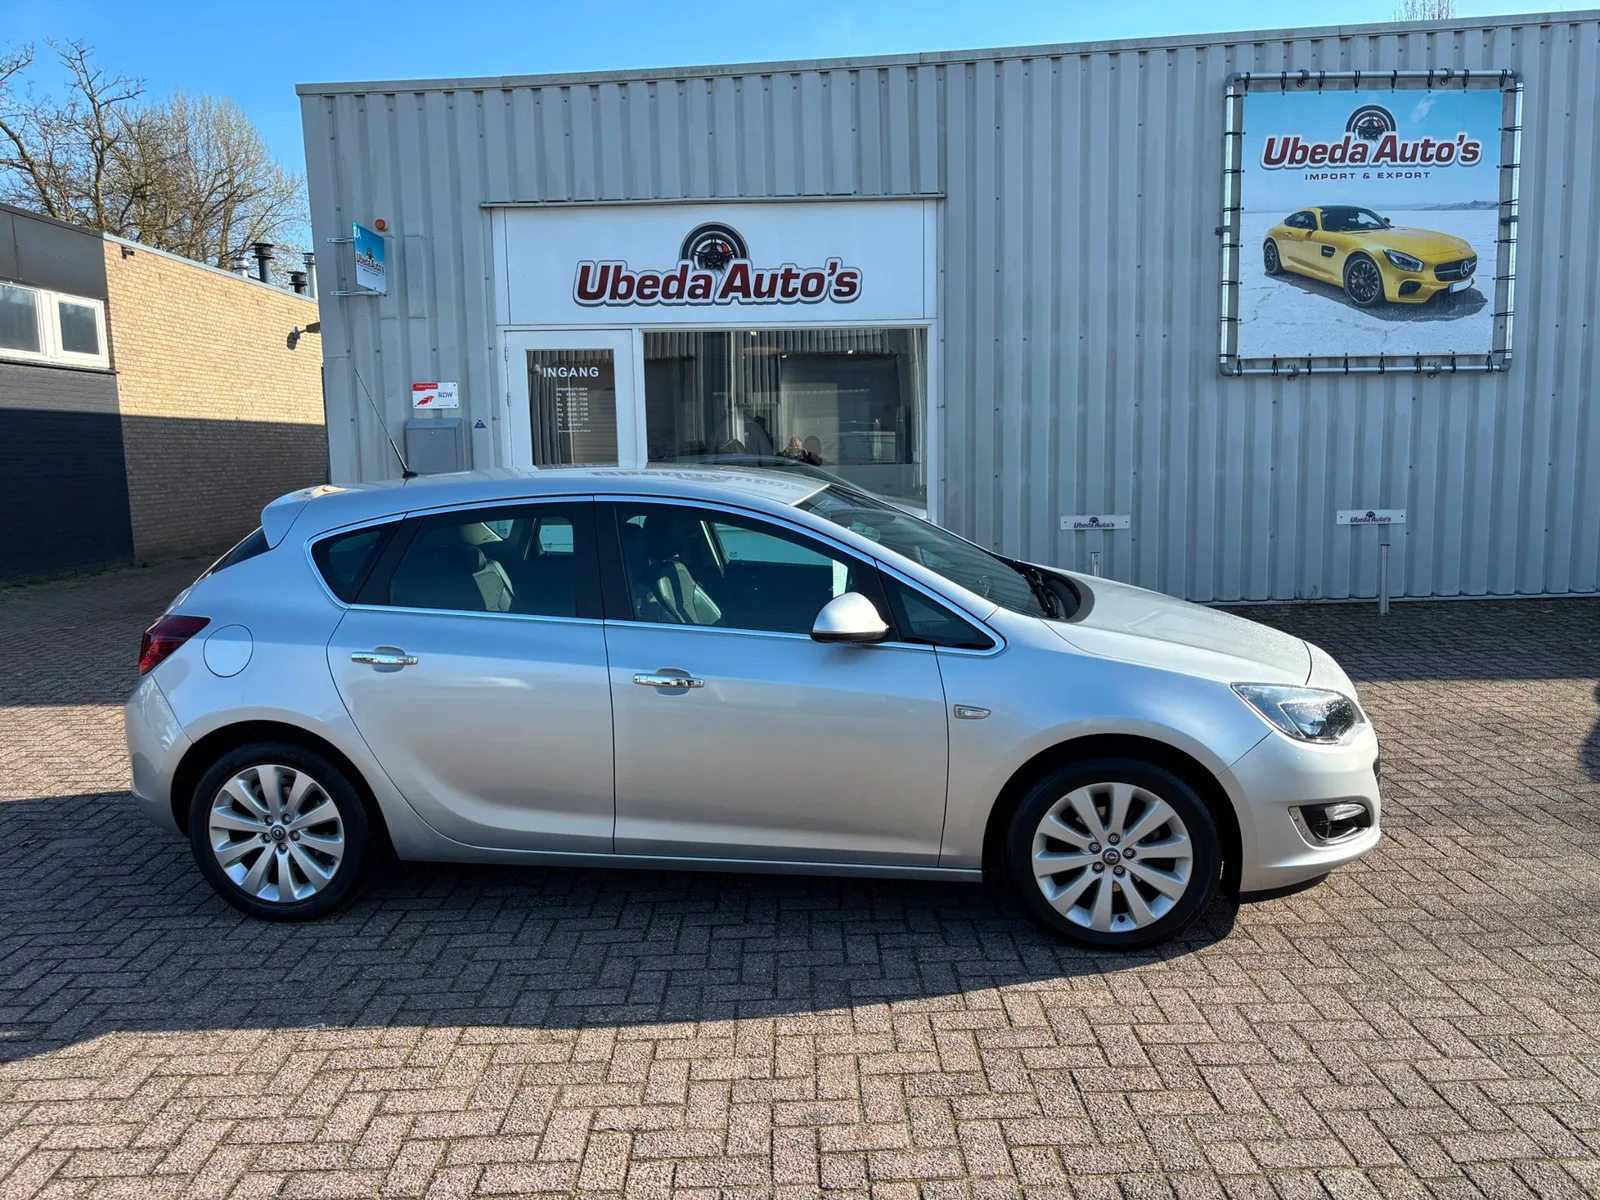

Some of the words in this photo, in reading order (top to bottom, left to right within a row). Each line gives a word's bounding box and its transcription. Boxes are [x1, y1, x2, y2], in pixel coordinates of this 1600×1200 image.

[1263, 135, 1369, 166] Ubeda
[1371, 134, 1481, 163] Auto's
[1304, 172, 1356, 181] IMPORT
[1362, 172, 1370, 180] &
[1377, 171, 1431, 180] EXPORT
[575, 262, 714, 303] Ubeda
[718, 260, 861, 301] Auto's
[543, 366, 599, 378] INGANG
[437, 391, 453, 399] RDW
